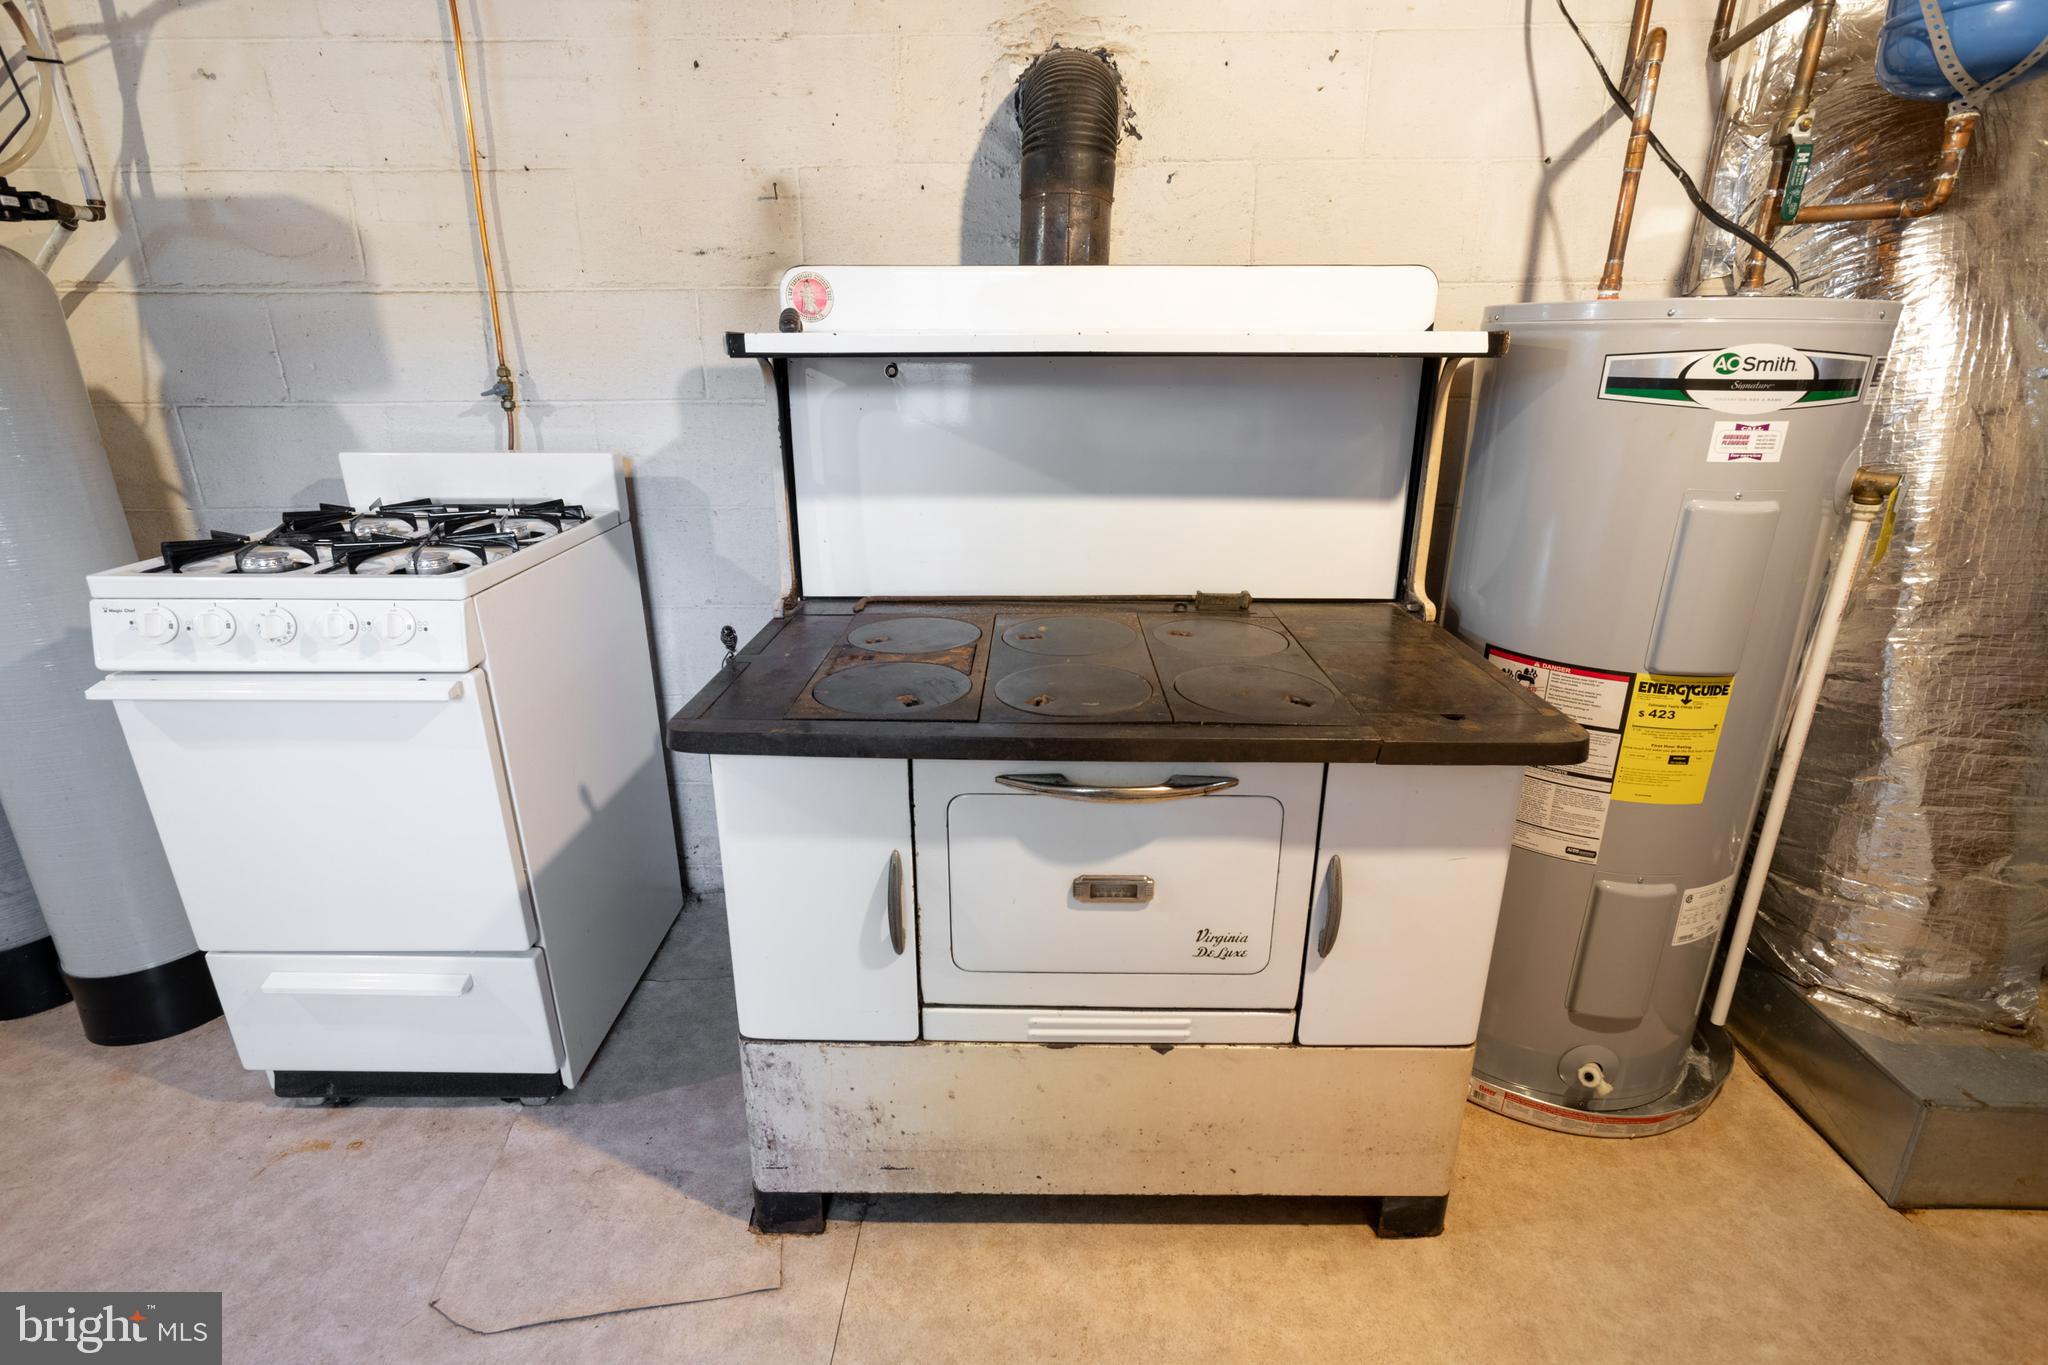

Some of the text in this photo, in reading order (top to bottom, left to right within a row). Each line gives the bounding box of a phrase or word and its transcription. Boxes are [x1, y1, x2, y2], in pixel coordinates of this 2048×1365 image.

[1743, 356, 1798, 372] Smith
[1542, 663, 1571, 674] DANGER
[1648, 709, 1676, 720] 423
[1196, 928, 1249, 947] Virginia
